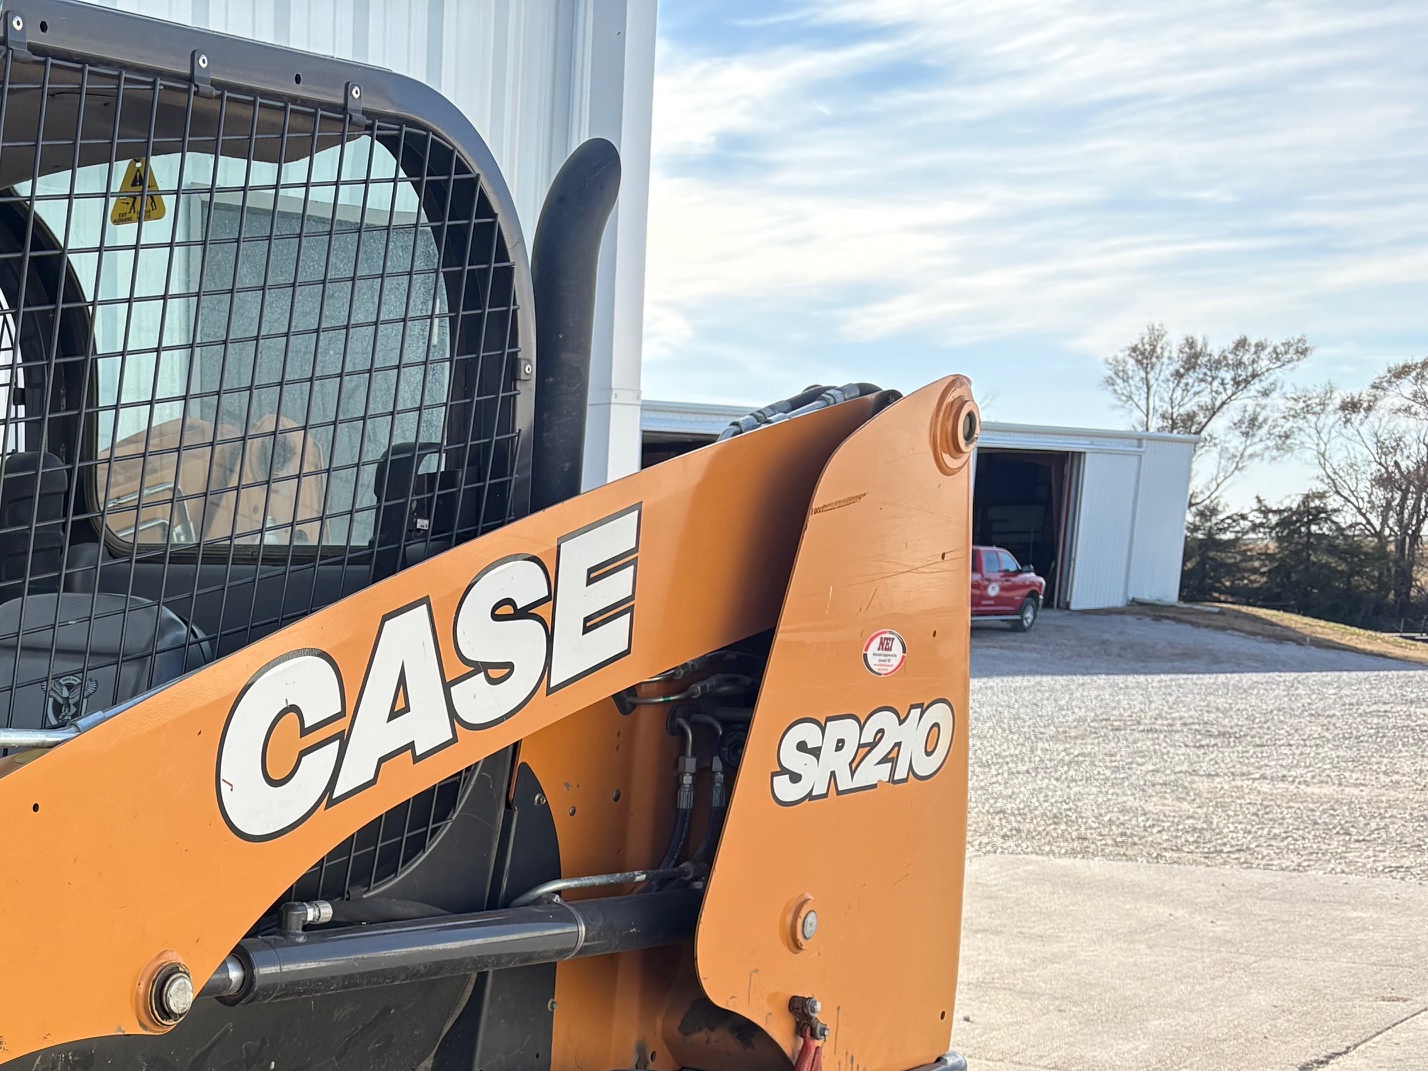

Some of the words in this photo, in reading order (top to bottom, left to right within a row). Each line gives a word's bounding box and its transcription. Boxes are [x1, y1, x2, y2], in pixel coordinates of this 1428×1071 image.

[215, 501, 643, 843] CASE
[877, 636, 895, 651] NEI
[770, 697, 956, 808] SR210
